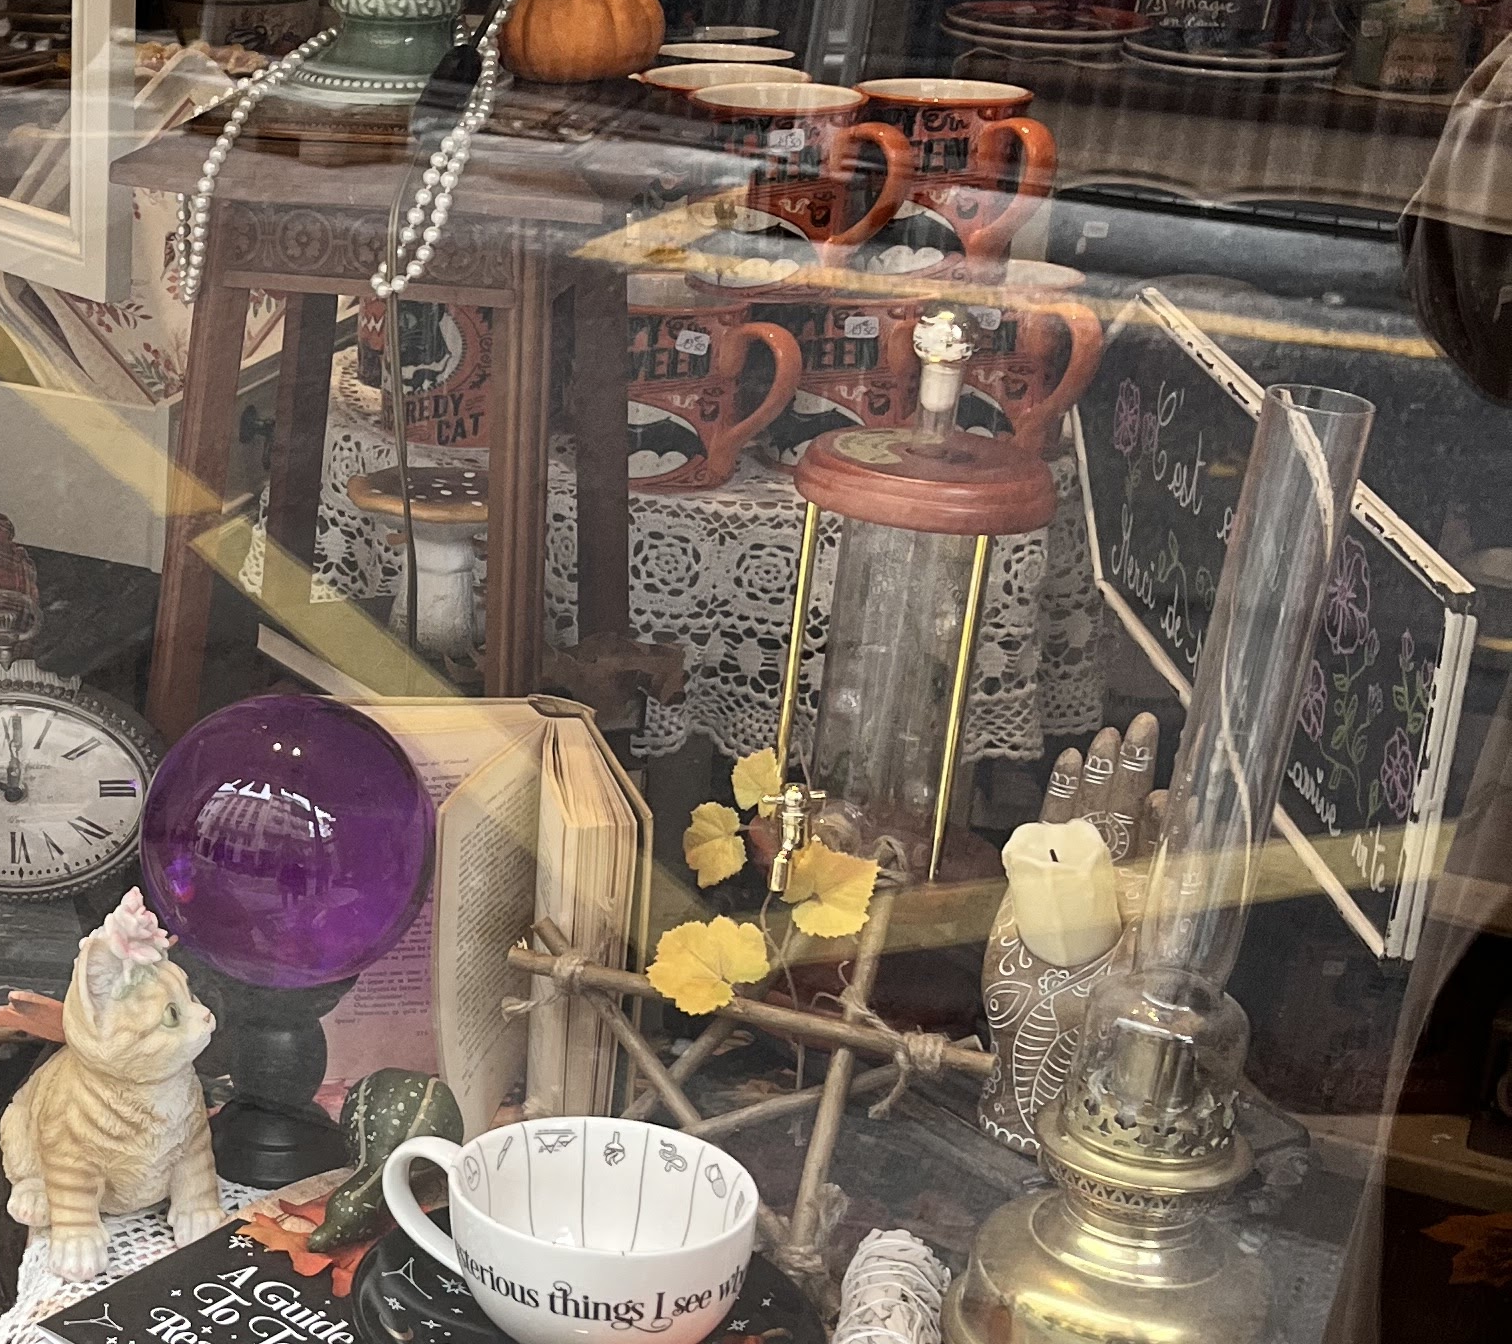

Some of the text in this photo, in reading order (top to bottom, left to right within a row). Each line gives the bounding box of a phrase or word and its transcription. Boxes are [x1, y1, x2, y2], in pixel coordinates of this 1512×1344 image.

[437, 412, 485, 445] CAT
[217, 1266, 259, 1289] A
[193, 1282, 252, 1326] To
[547, 1280, 645, 1331] things
[672, 1289, 713, 1317] see
